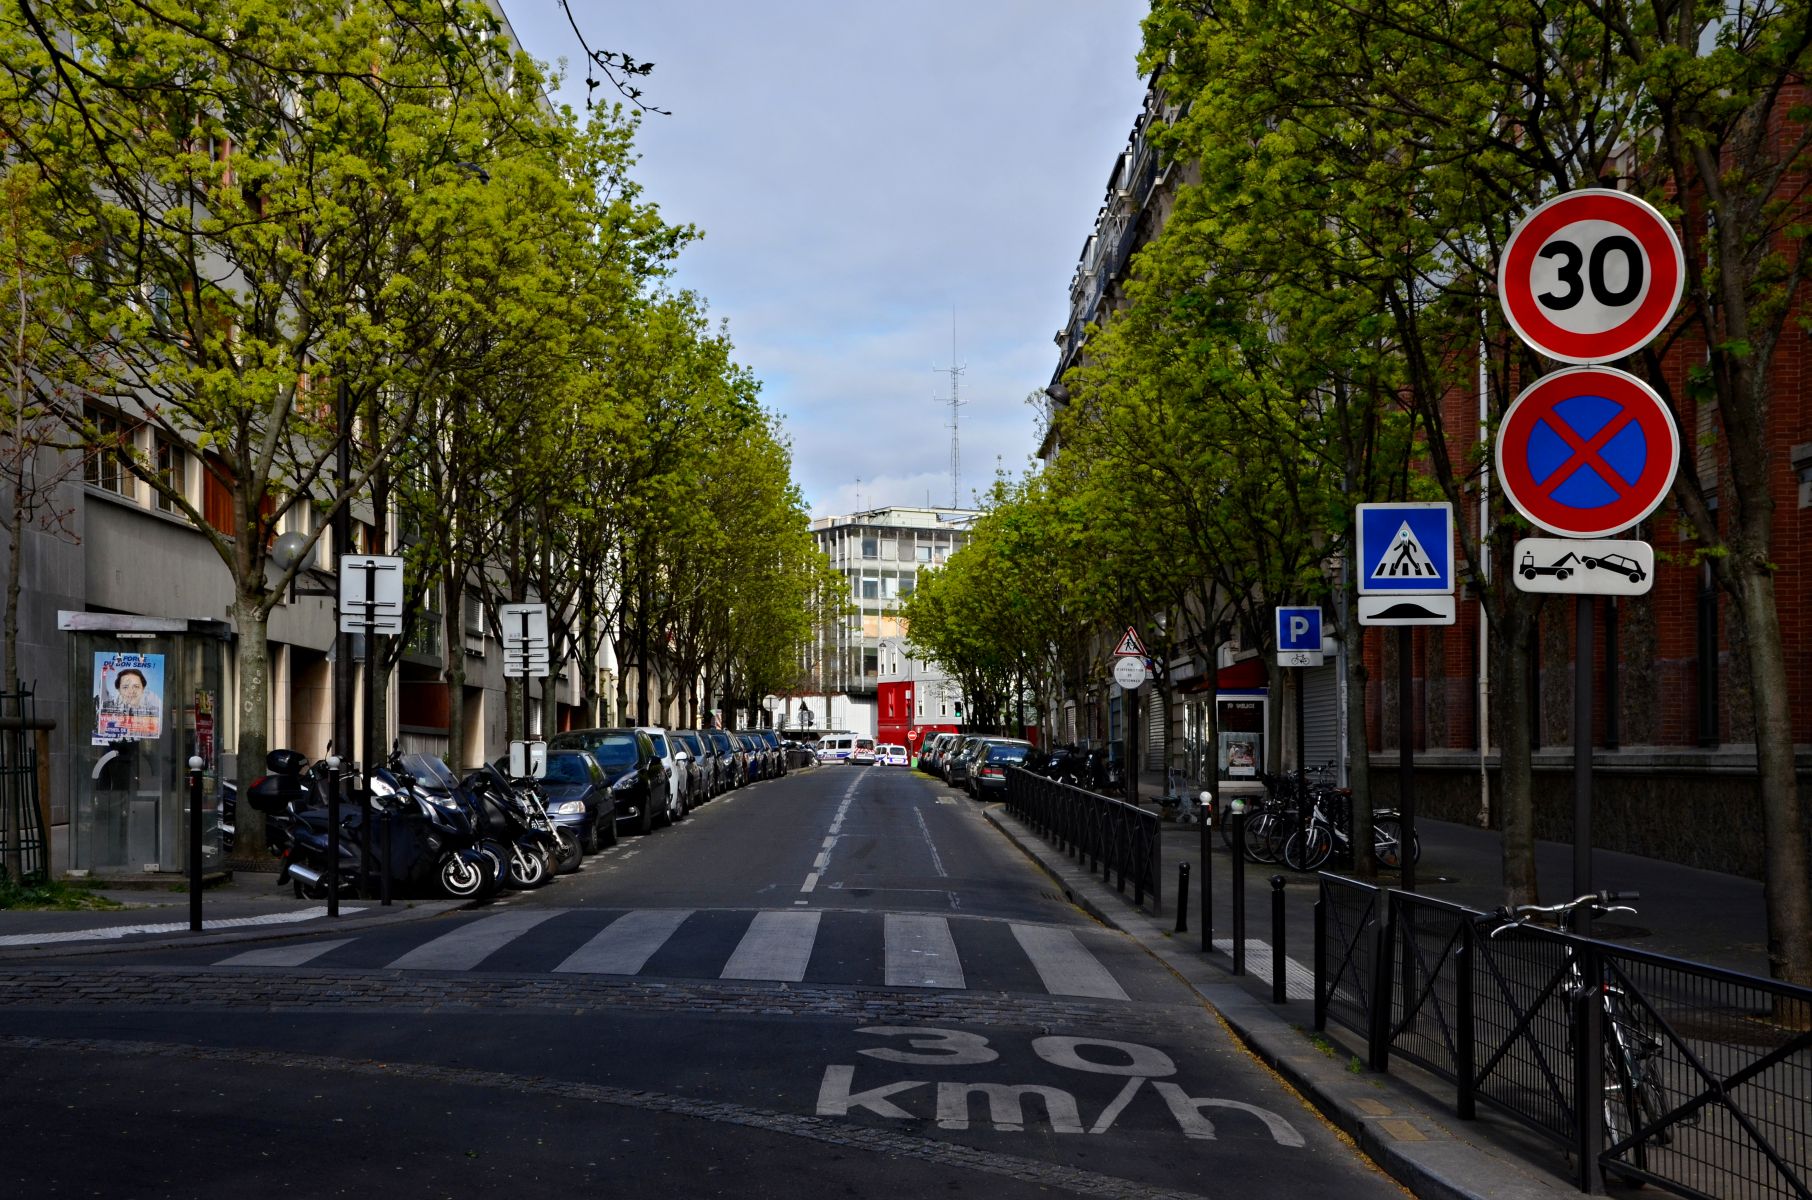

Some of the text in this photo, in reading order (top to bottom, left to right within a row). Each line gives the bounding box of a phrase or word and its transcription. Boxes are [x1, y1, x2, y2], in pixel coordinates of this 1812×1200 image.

[1538, 236, 1643, 310] 30
[1290, 616, 1310, 643] P
[852, 1025, 1177, 1077] 30
[816, 1065, 1306, 1147] km/h
